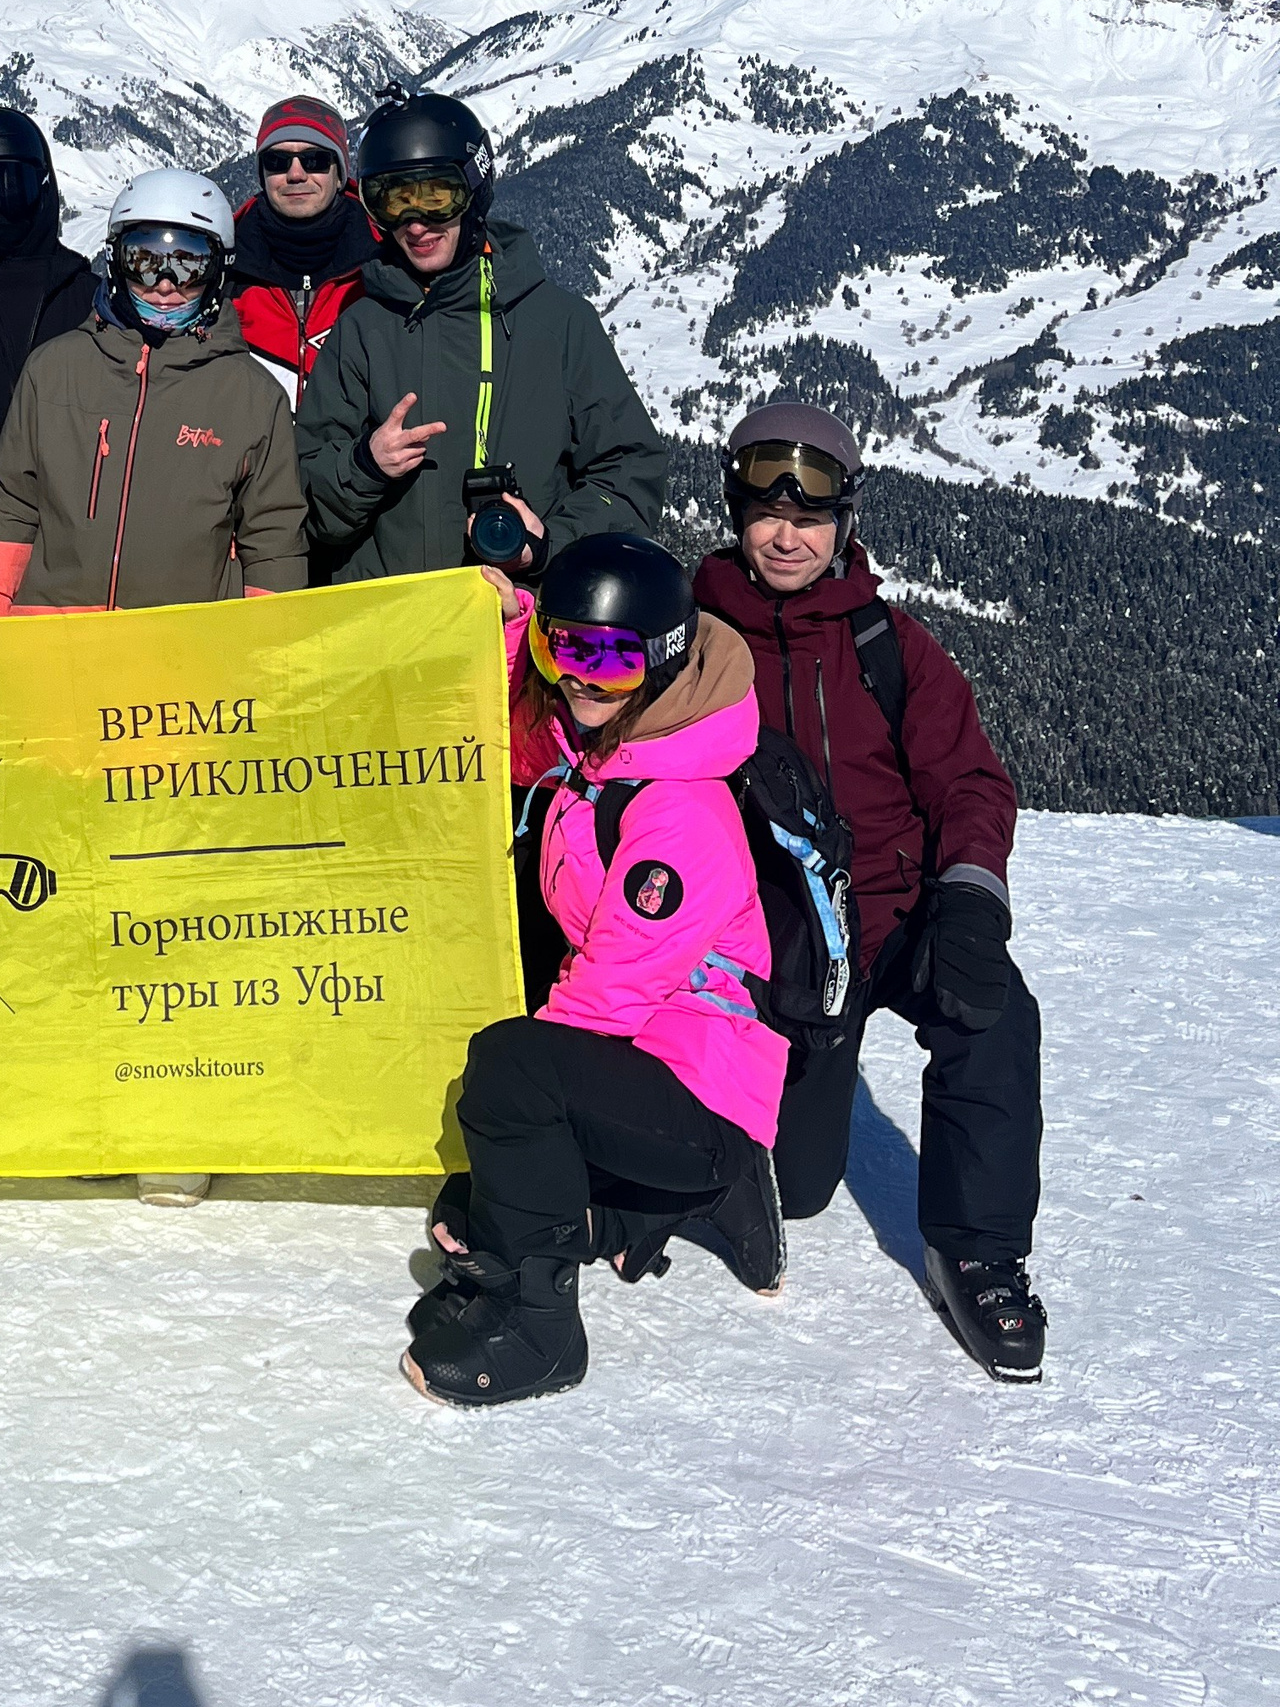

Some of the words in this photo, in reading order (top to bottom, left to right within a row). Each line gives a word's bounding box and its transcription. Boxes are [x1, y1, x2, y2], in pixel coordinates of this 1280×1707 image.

[98, 698, 257, 742] ВРЕМЯ
[102, 735, 486, 803] ПРИКЛЮЧЕНИЙ
[110, 905, 409, 956] Горнолыжные
[112, 979, 220, 1024] туры
[233, 978, 280, 1006] из
[292, 961, 385, 1016] Уфы
[115, 1057, 264, 1082] @snowskitours
